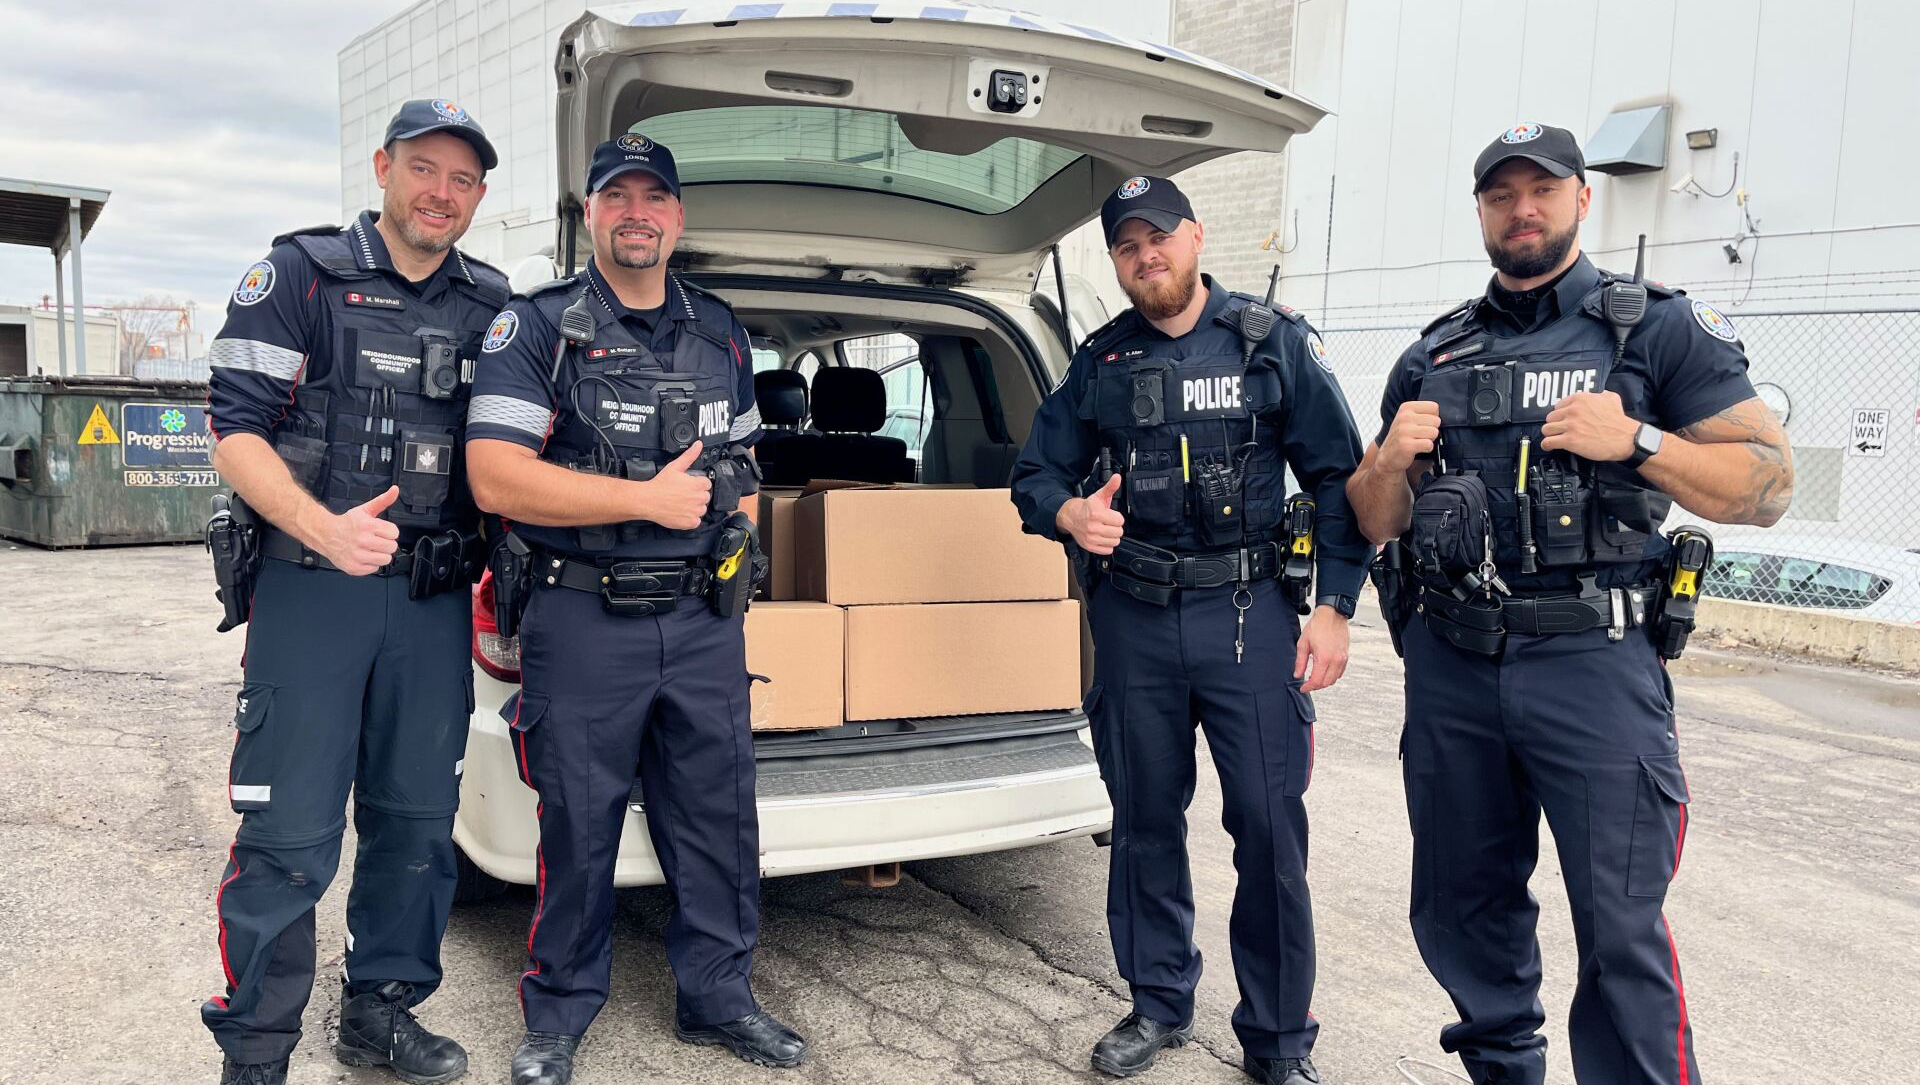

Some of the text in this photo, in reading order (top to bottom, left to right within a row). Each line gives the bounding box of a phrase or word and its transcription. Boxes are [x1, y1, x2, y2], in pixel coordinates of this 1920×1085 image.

[361, 349, 422, 365] NEIGHBOURHOOD
[370, 357, 412, 369] COMMUNITY
[376, 364, 406, 374] OFFICER
[1183, 375, 1242, 412] POLICE
[1523, 369, 1597, 408] POLICE
[698, 400, 730, 437] POLICE
[1858, 411, 1886, 424] ONE
[614, 422, 641, 433] OFFICER
[1854, 426, 1884, 439] WAY
